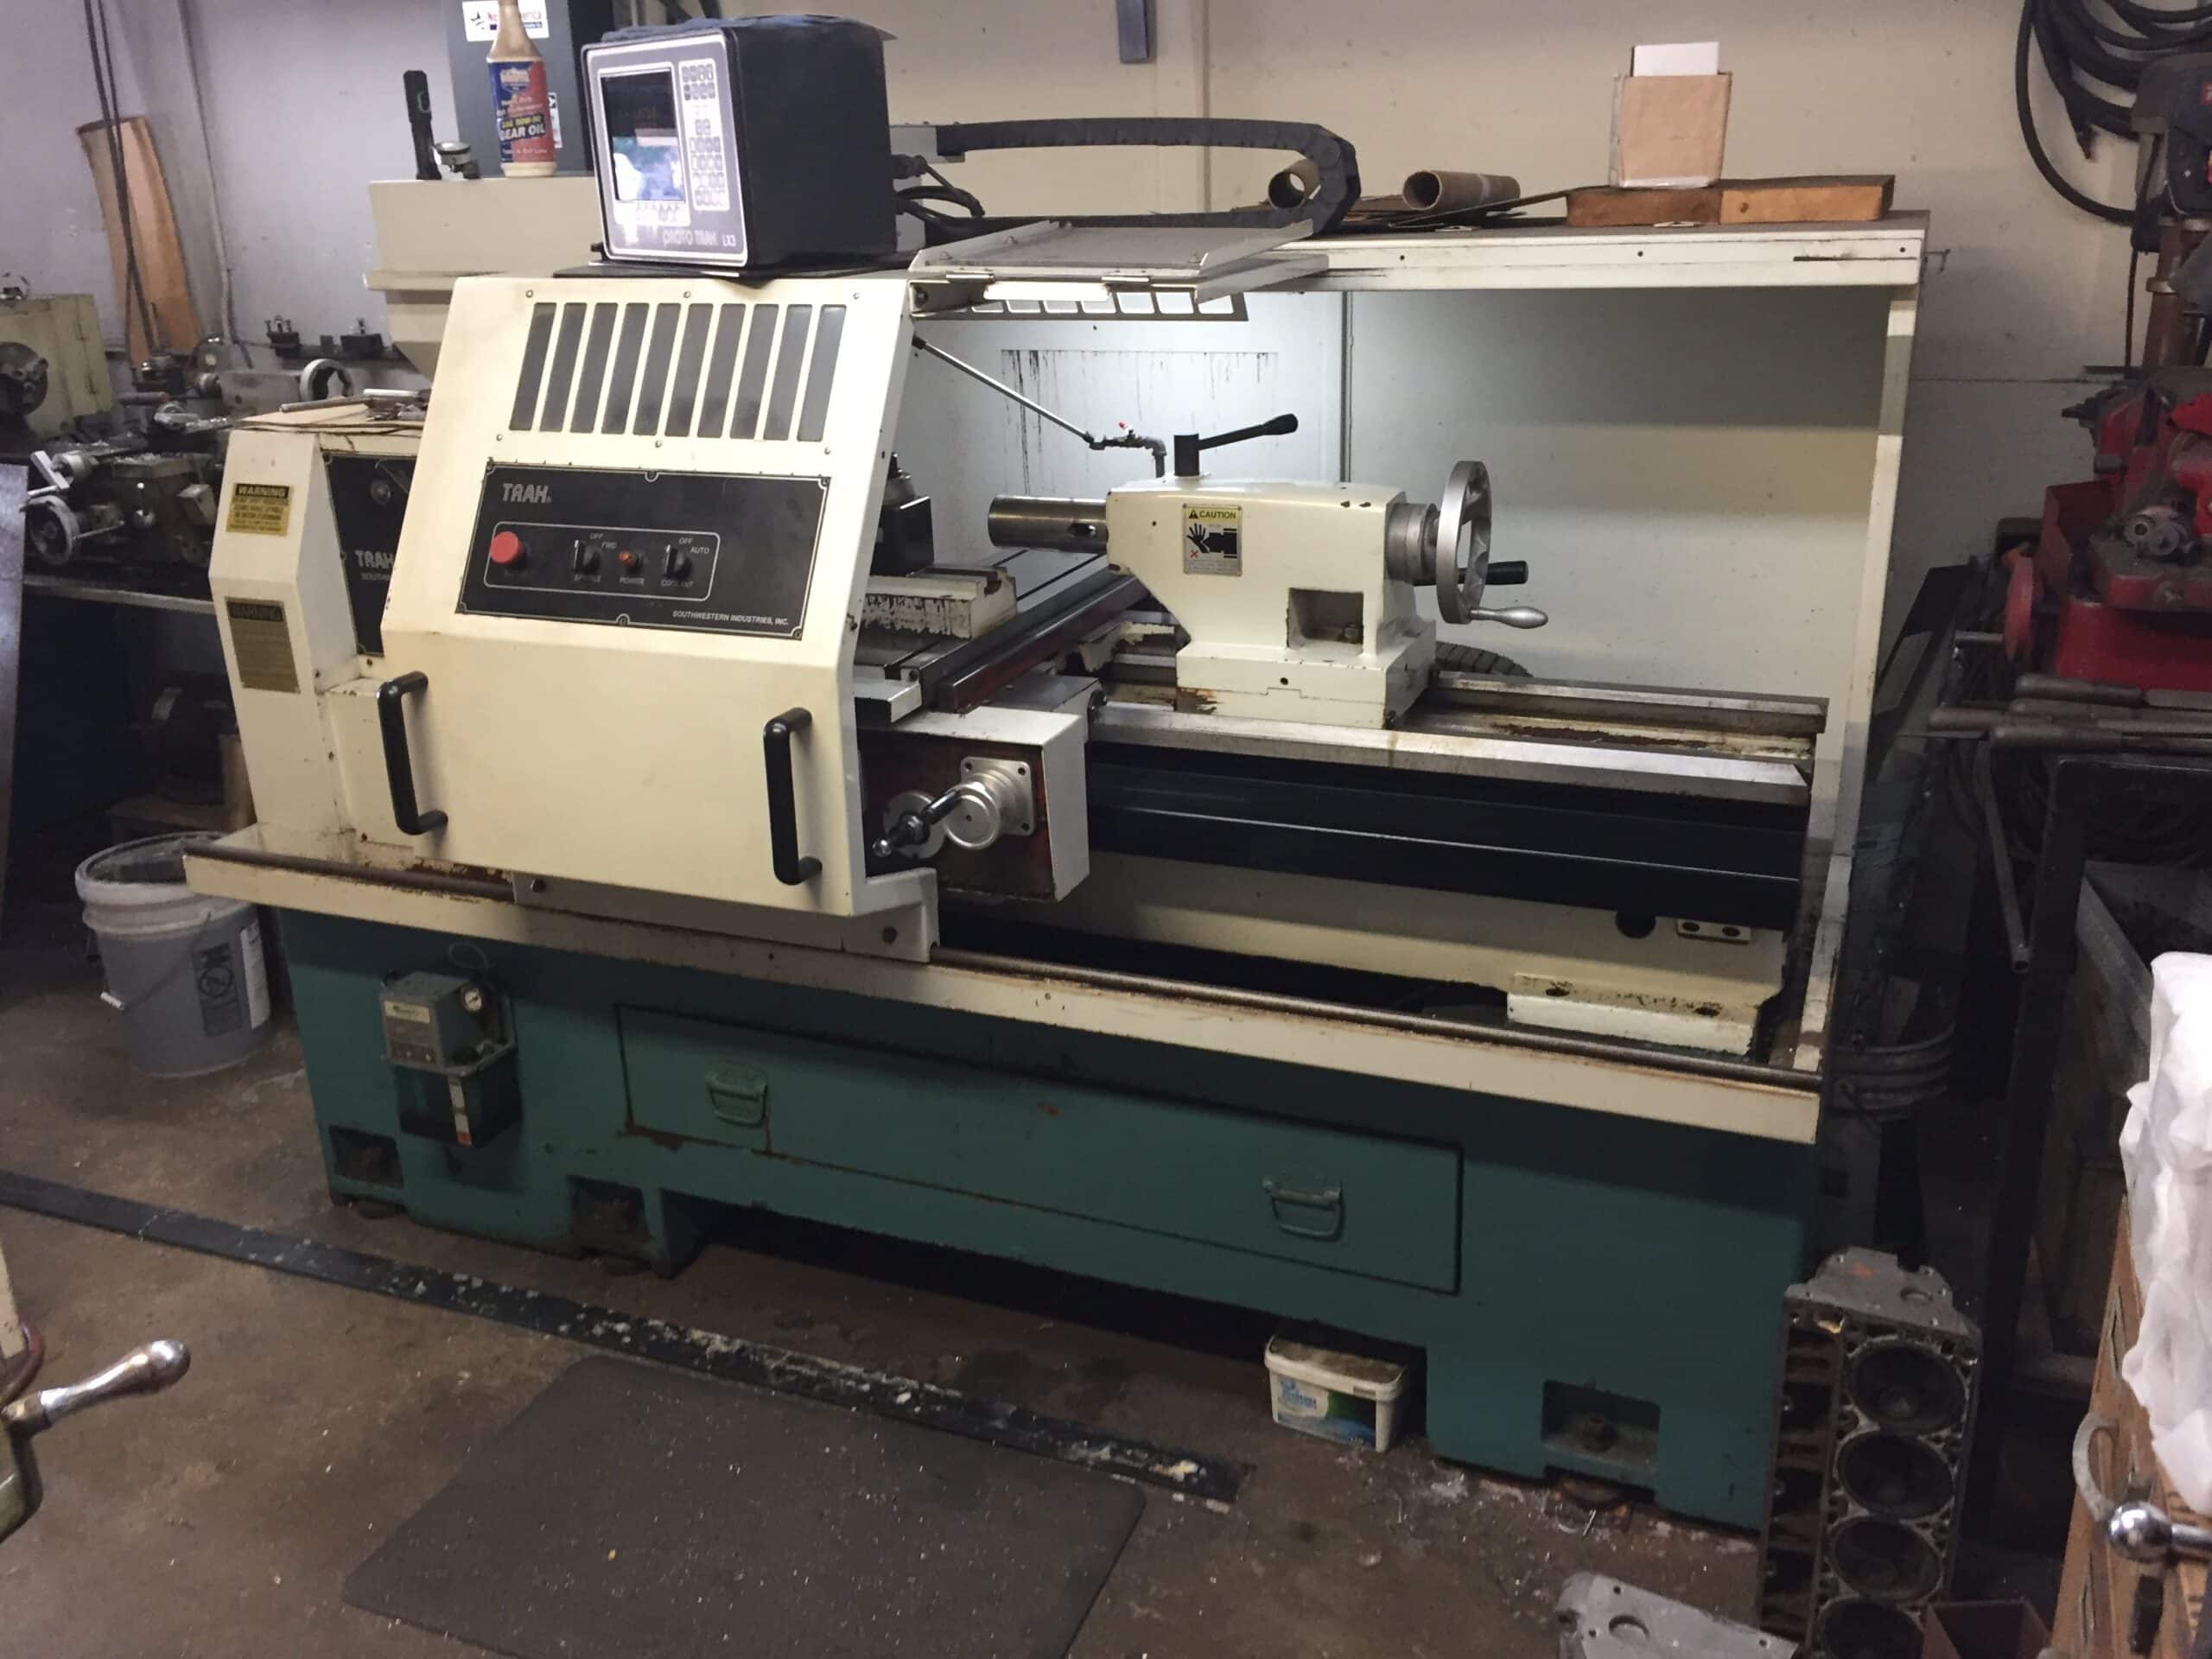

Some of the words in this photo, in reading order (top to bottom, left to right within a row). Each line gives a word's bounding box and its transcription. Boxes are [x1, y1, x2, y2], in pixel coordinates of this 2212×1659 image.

[529, 124, 545, 135] OIL
[238, 486, 285, 498] WARNING
[1199, 511, 1236, 519] CAUTION
[672, 610, 729, 621] SOUTHWESTERN
